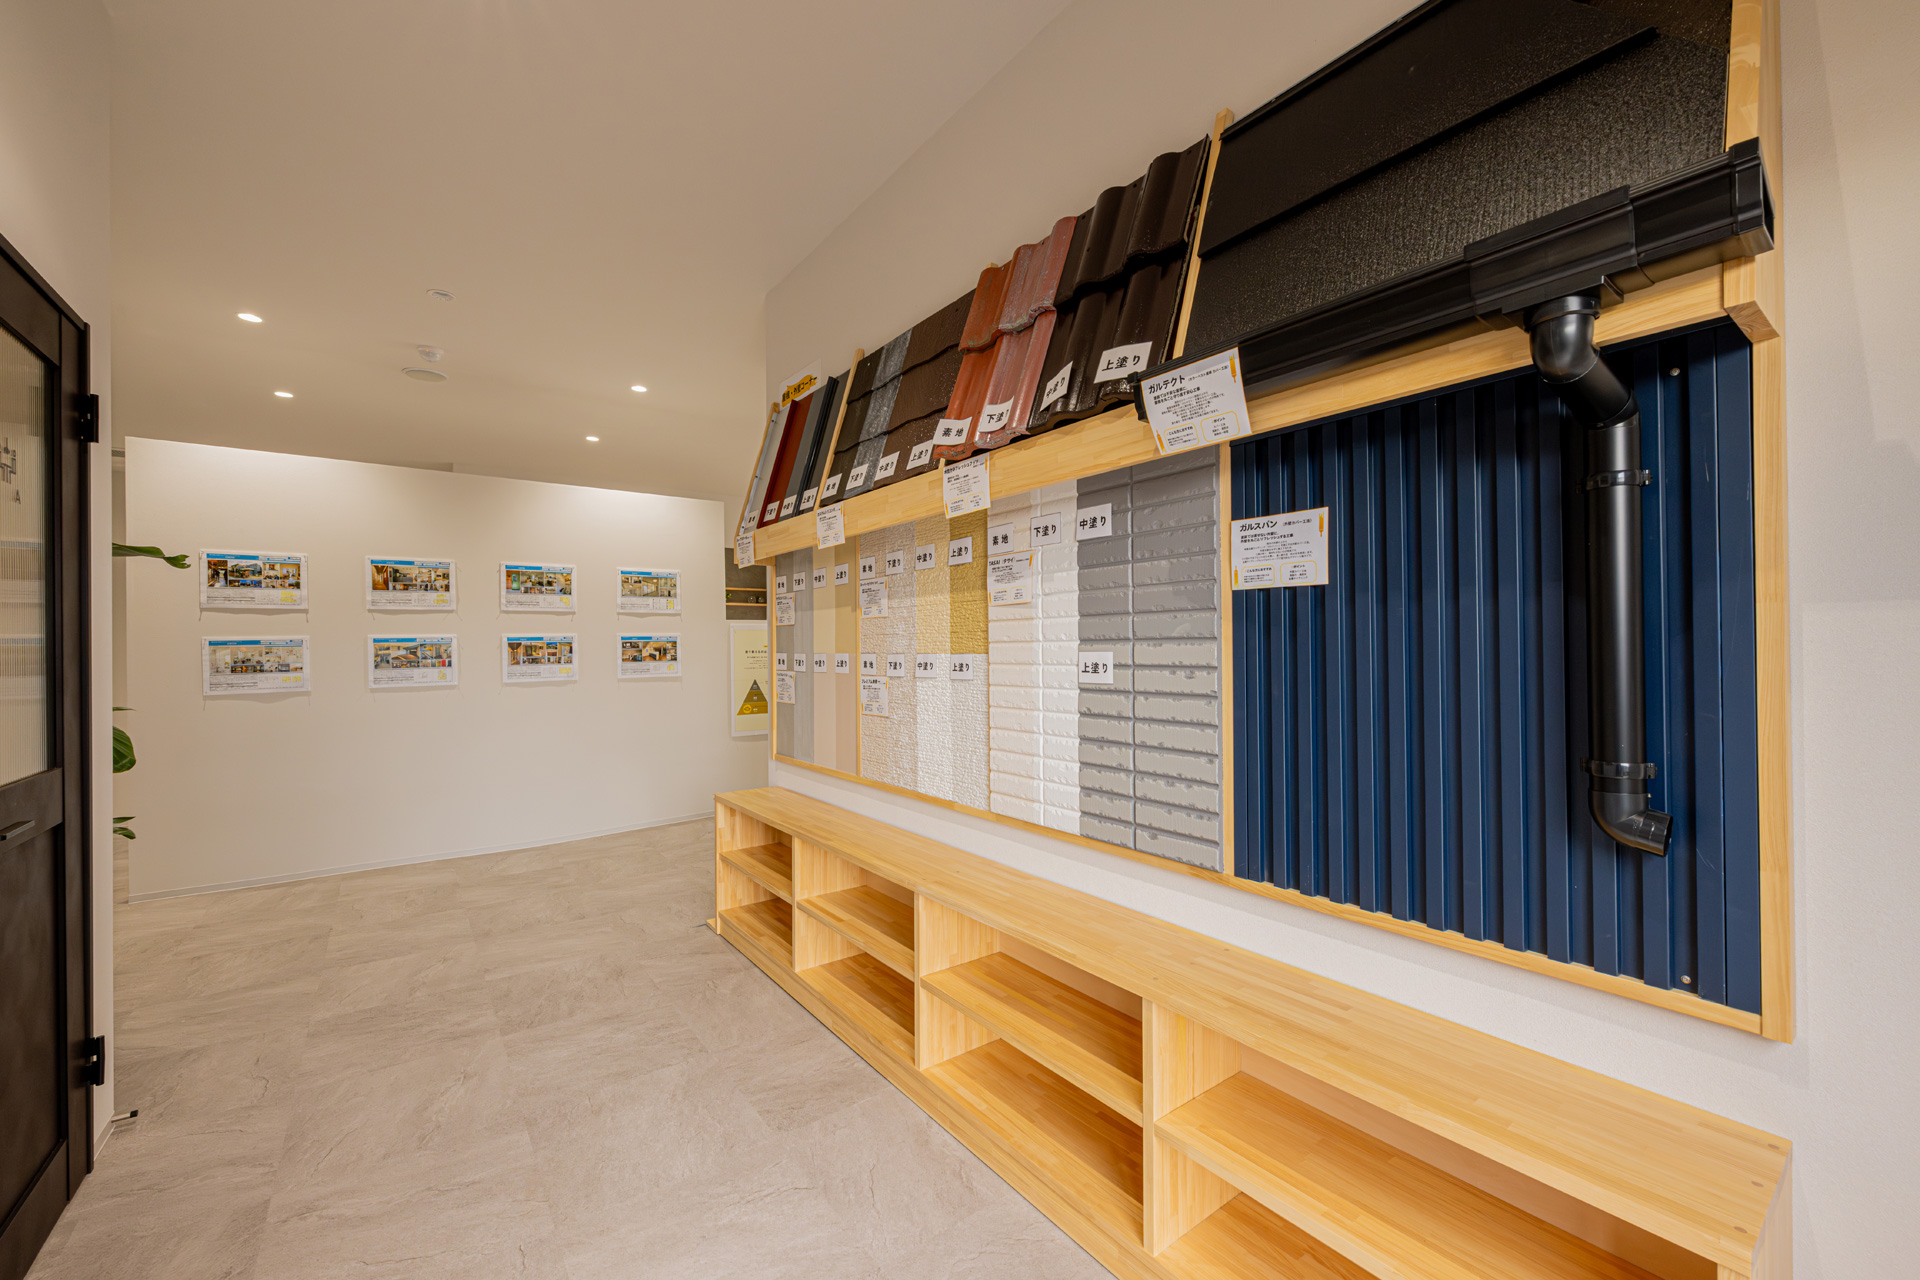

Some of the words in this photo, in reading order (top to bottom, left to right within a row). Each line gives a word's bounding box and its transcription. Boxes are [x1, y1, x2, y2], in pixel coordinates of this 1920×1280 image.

[1101, 354, 1141, 372] 上塗り
[1046, 377, 1066, 399] 中塗り
[1148, 374, 1186, 395] ガルテクト
[986, 408, 1009, 424] 下塗り
[942, 427, 964, 438] 素地
[910, 448, 929, 462] 上塗り
[878, 461, 894, 473] 中塗り
[850, 472, 864, 484] 下塗り
[1079, 516, 1107, 531] 中塗り
[1239, 519, 1278, 533] ガルスパン
[1033, 524, 1057, 538] 下塗り
[991, 533, 1009, 546] 素地
[916, 552, 933, 563] 中塗り
[950, 546, 969, 558] 上塗り
[862, 564, 873, 573] 素地
[887, 559, 901, 569] 下塗り
[835, 570, 847, 580] 上塗り
[862, 660, 874, 670] 素地
[888, 661, 903, 671] 下塗り
[917, 661, 934, 671] 中塗り
[952, 662, 970, 673] 上塗り
[1081, 661, 1108, 674] 上塗り
